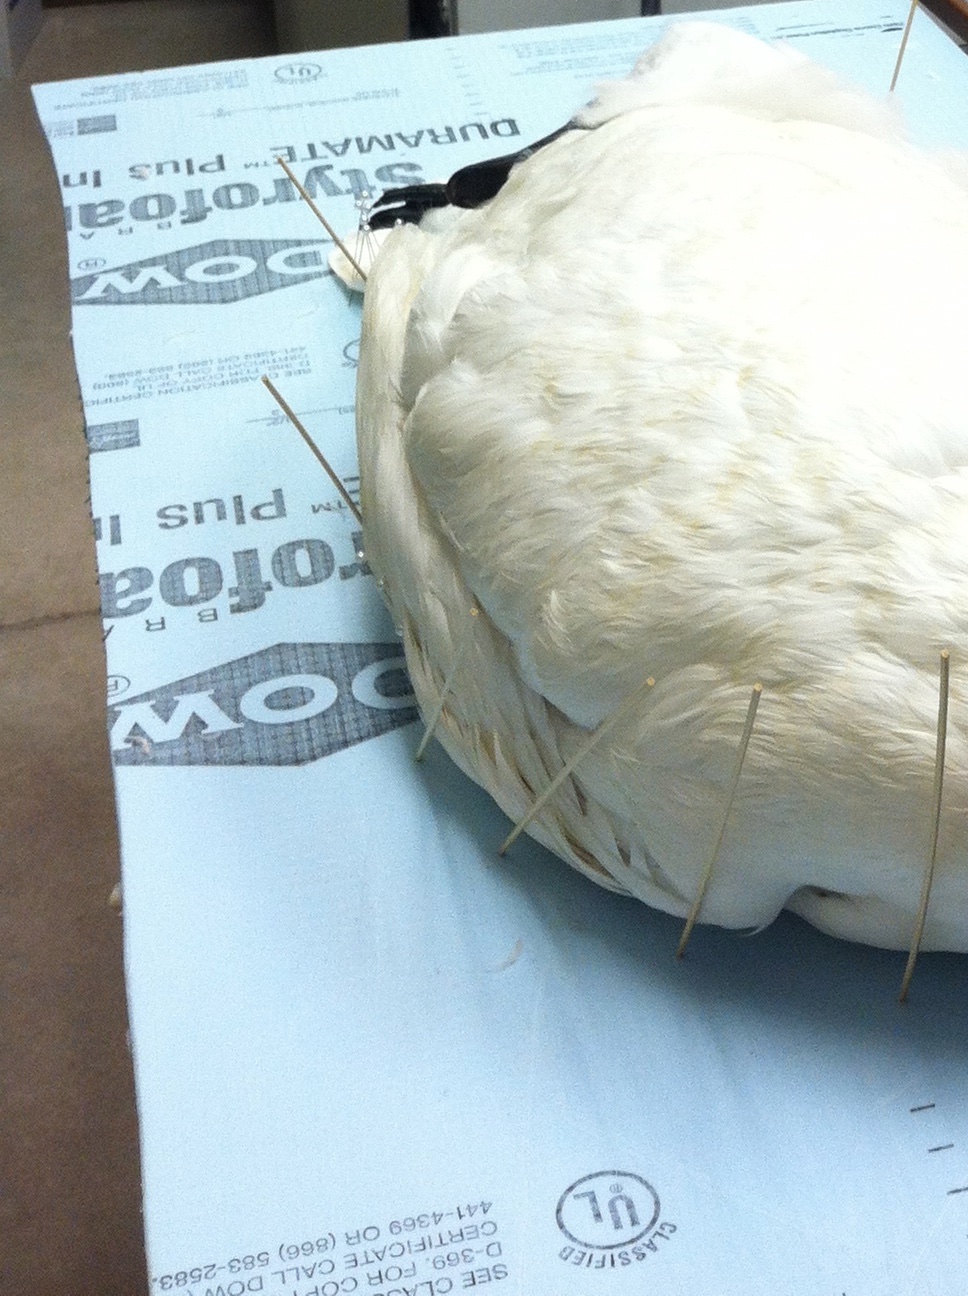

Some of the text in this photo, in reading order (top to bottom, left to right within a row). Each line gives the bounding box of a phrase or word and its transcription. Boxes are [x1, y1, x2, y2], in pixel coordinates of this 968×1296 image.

[128, 154, 226, 182] Plus
[71, 244, 330, 302] DOW
[156, 488, 288, 531] Plus
[107, 655, 415, 751] DOW
[151, 1200, 493, 1291] 441-4369 OR (866) 583-2583.
[344, 1220, 499, 1270] CERTIFICATE
[425, 1241, 503, 1271] D-369.
[557, 1220, 678, 1271] CLASSIFIED
[271, 1259, 336, 1284] CALL
[366, 1262, 417, 1287] FOR
[462, 1263, 509, 1289] SEE
